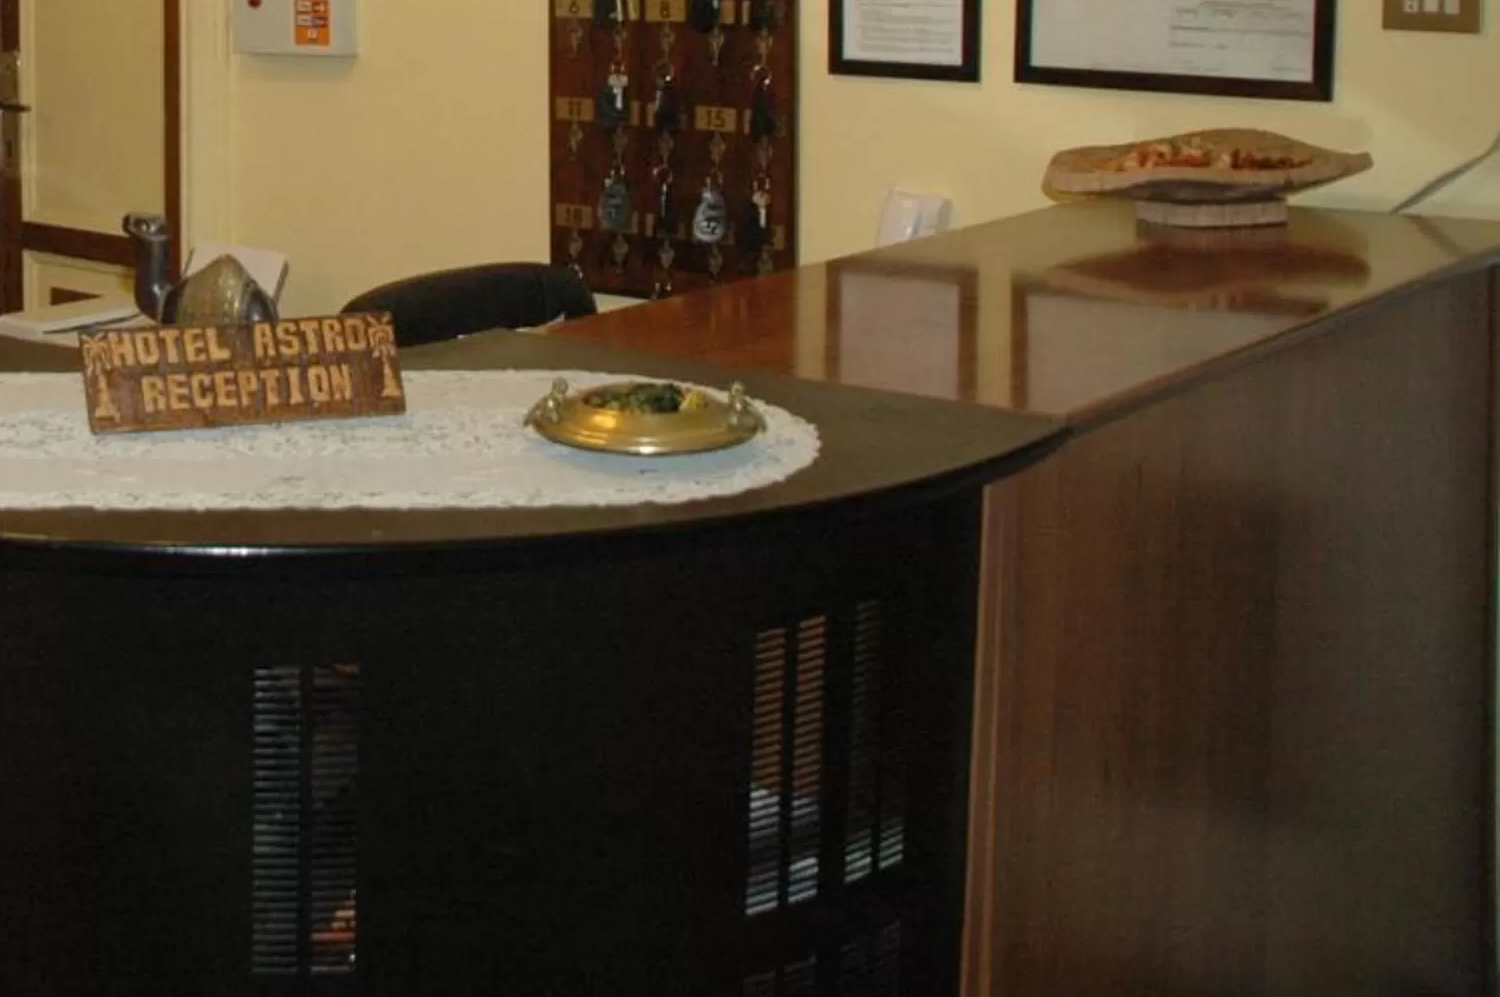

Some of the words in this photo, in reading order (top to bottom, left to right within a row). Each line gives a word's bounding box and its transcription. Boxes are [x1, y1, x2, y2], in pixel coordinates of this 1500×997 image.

[704, 112, 726, 129] 15
[109, 327, 232, 367] HOTEL
[252, 317, 372, 358] ASTRO
[141, 363, 351, 412] RECEPTION
